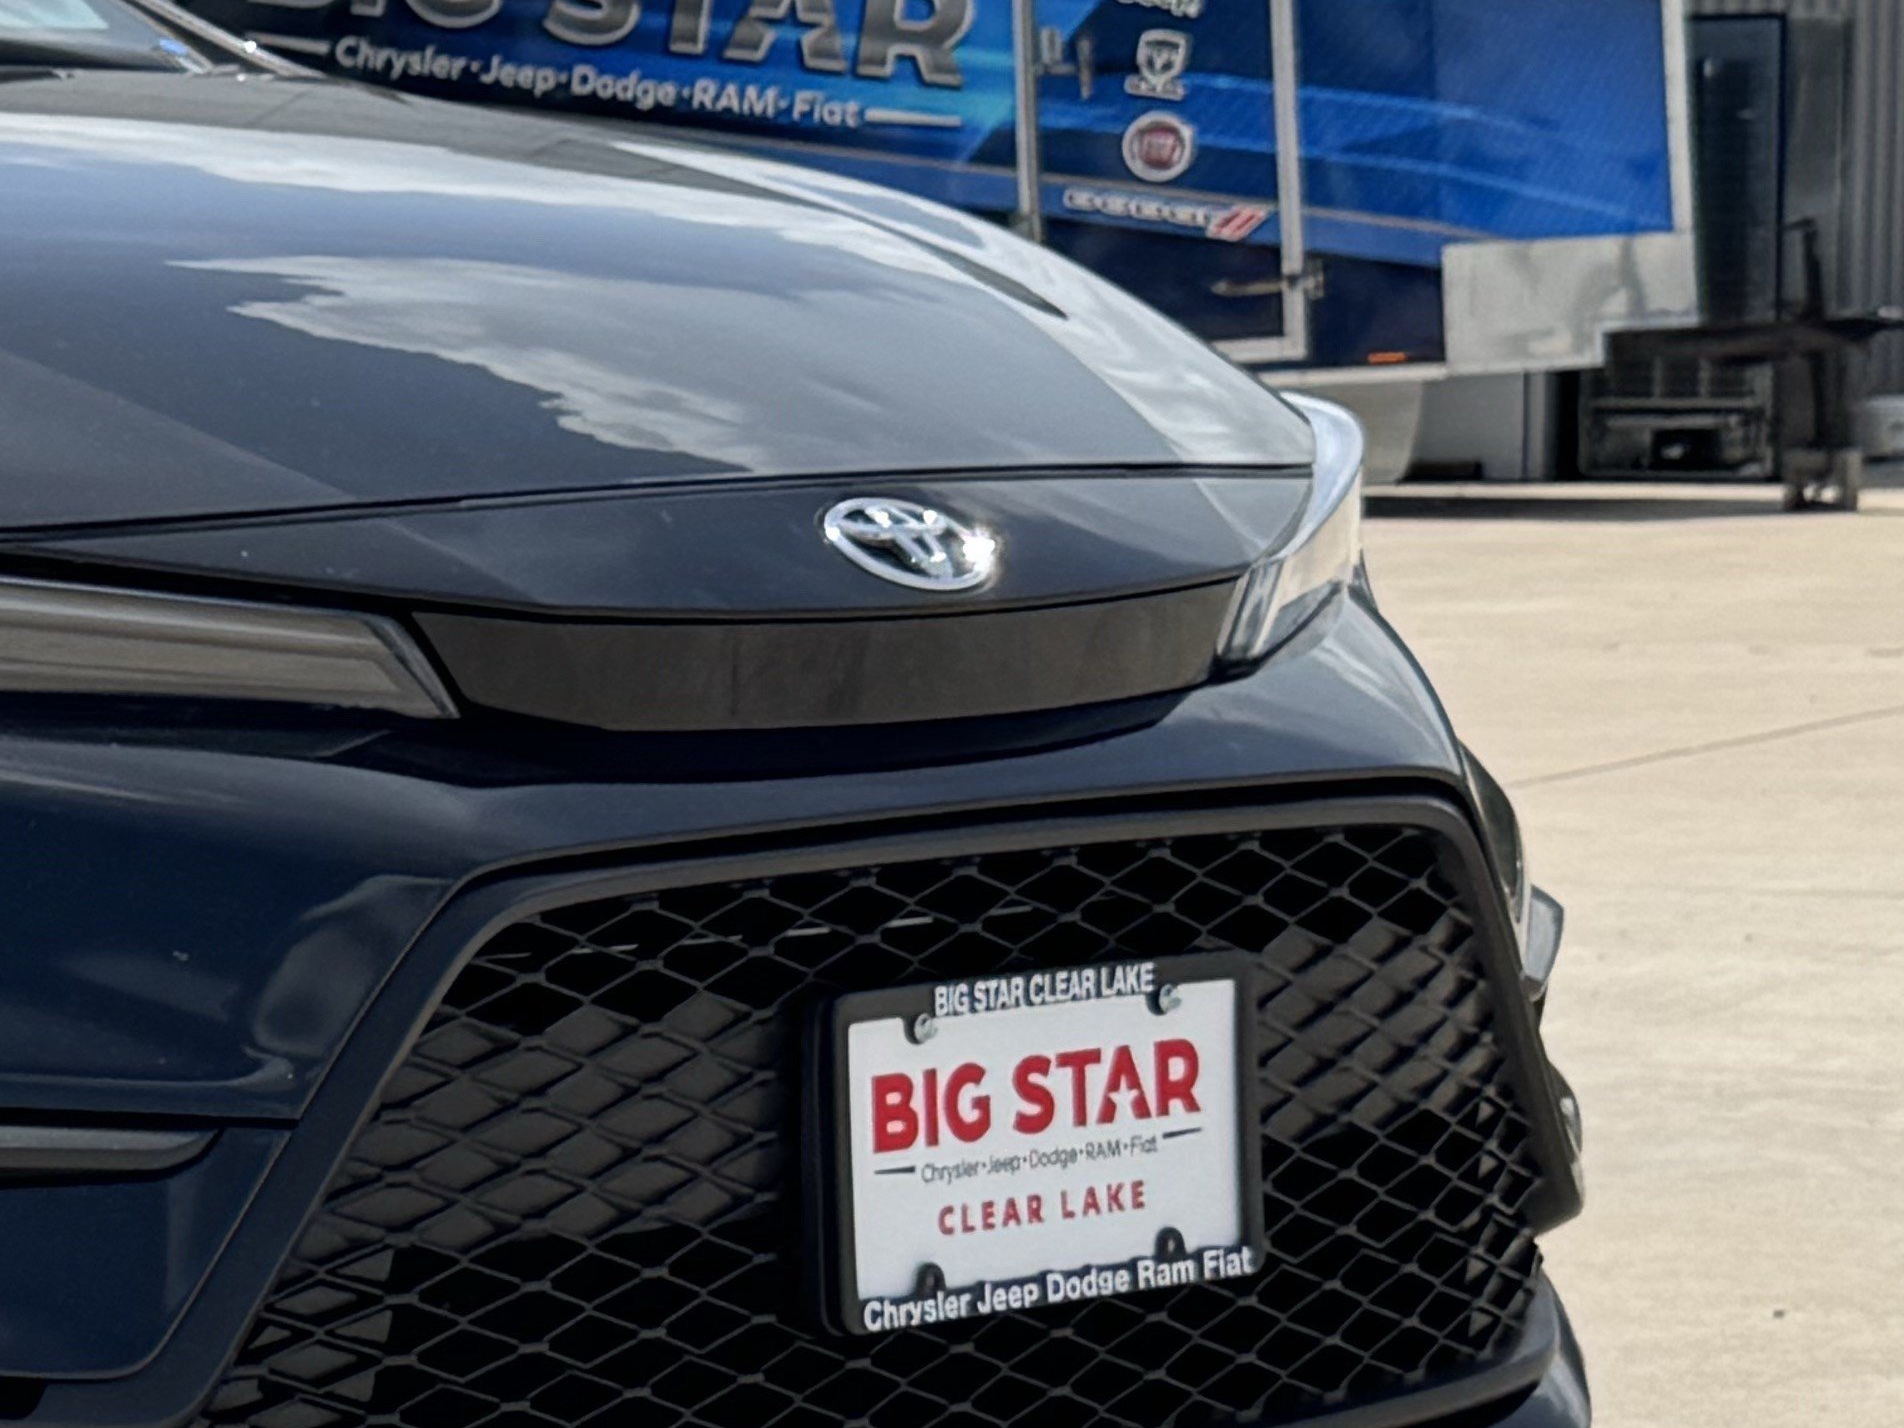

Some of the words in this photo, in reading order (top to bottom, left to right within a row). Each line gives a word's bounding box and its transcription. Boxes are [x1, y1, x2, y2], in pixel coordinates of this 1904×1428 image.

[335, 35, 467, 82] Chrysler
[479, 54, 557, 97] Jeep
[571, 64, 679, 111] Dodge
[692, 77, 778, 119] RAM
[792, 89, 861, 128] Fiat
[934, 984, 970, 1017] BIG
[973, 976, 1026, 1012] STAR
[1029, 968, 1096, 1003] CLEAR
[1101, 961, 1155, 996] LAKE
[870, 1062, 992, 1155] BIG
[1012, 1038, 1201, 1135] STAR
[921, 1159, 979, 1186] Chrysler
[1029, 1148, 1078, 1170] Dodge
[1086, 1139, 1122, 1161] RAM
[1130, 1134, 1158, 1155] Fiat
[937, 1193, 1045, 1237] CLEAR
[1061, 1179, 1147, 1221] LAKE
[863, 1291, 972, 1333] Chrysler
[977, 1278, 1040, 1314] Jeep
[1046, 1264, 1130, 1302] Dodge
[1137, 1256, 1193, 1291] Ram
[1203, 1244, 1254, 1281] Fiat
